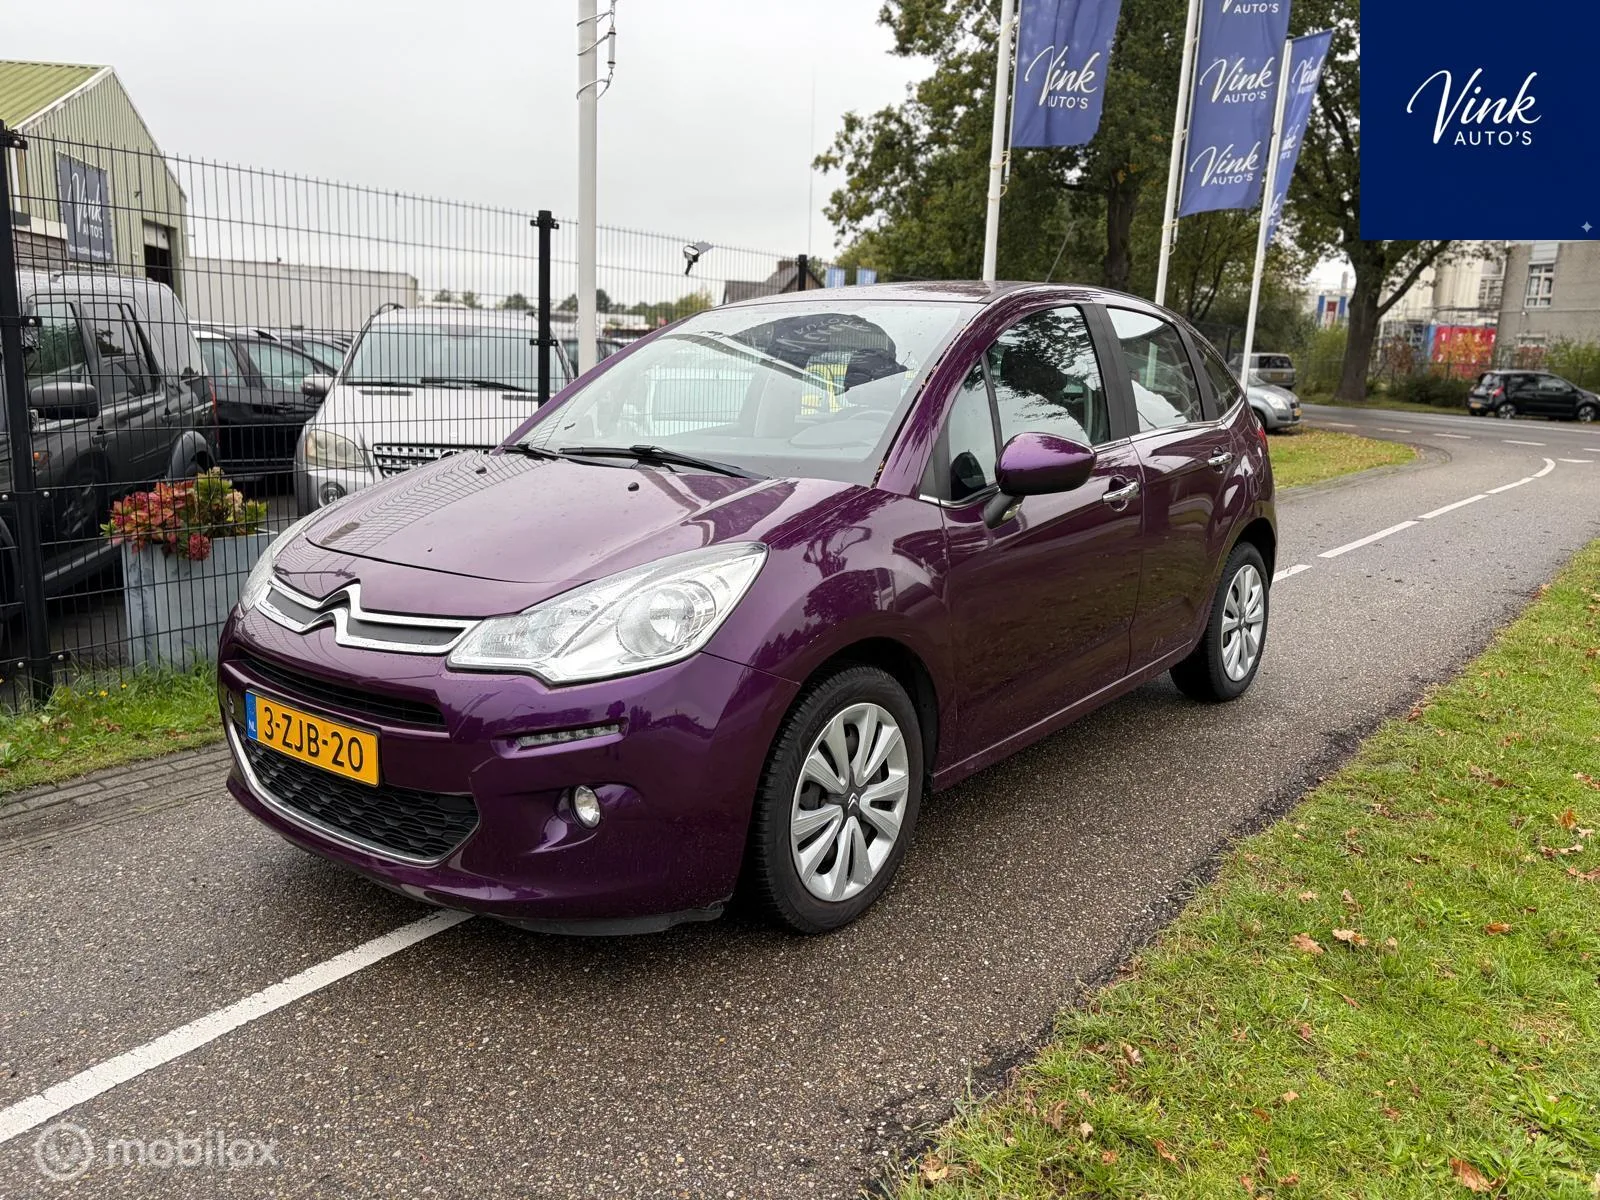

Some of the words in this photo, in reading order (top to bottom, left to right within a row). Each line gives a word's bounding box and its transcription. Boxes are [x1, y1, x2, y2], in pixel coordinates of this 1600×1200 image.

[1233, 3, 1279, 14] AUTO'S
[1024, 45, 1101, 107] Vink
[1199, 57, 1275, 103] Vink
[1223, 91, 1267, 104] AUTO'S
[1047, 95, 1089, 110] UTO'S
[1189, 141, 1261, 187] Vink
[1210, 173, 1254, 185] AUTO'S
[67, 172, 104, 233] Vink
[264, 706, 364, 772] 3-ZJB-20
